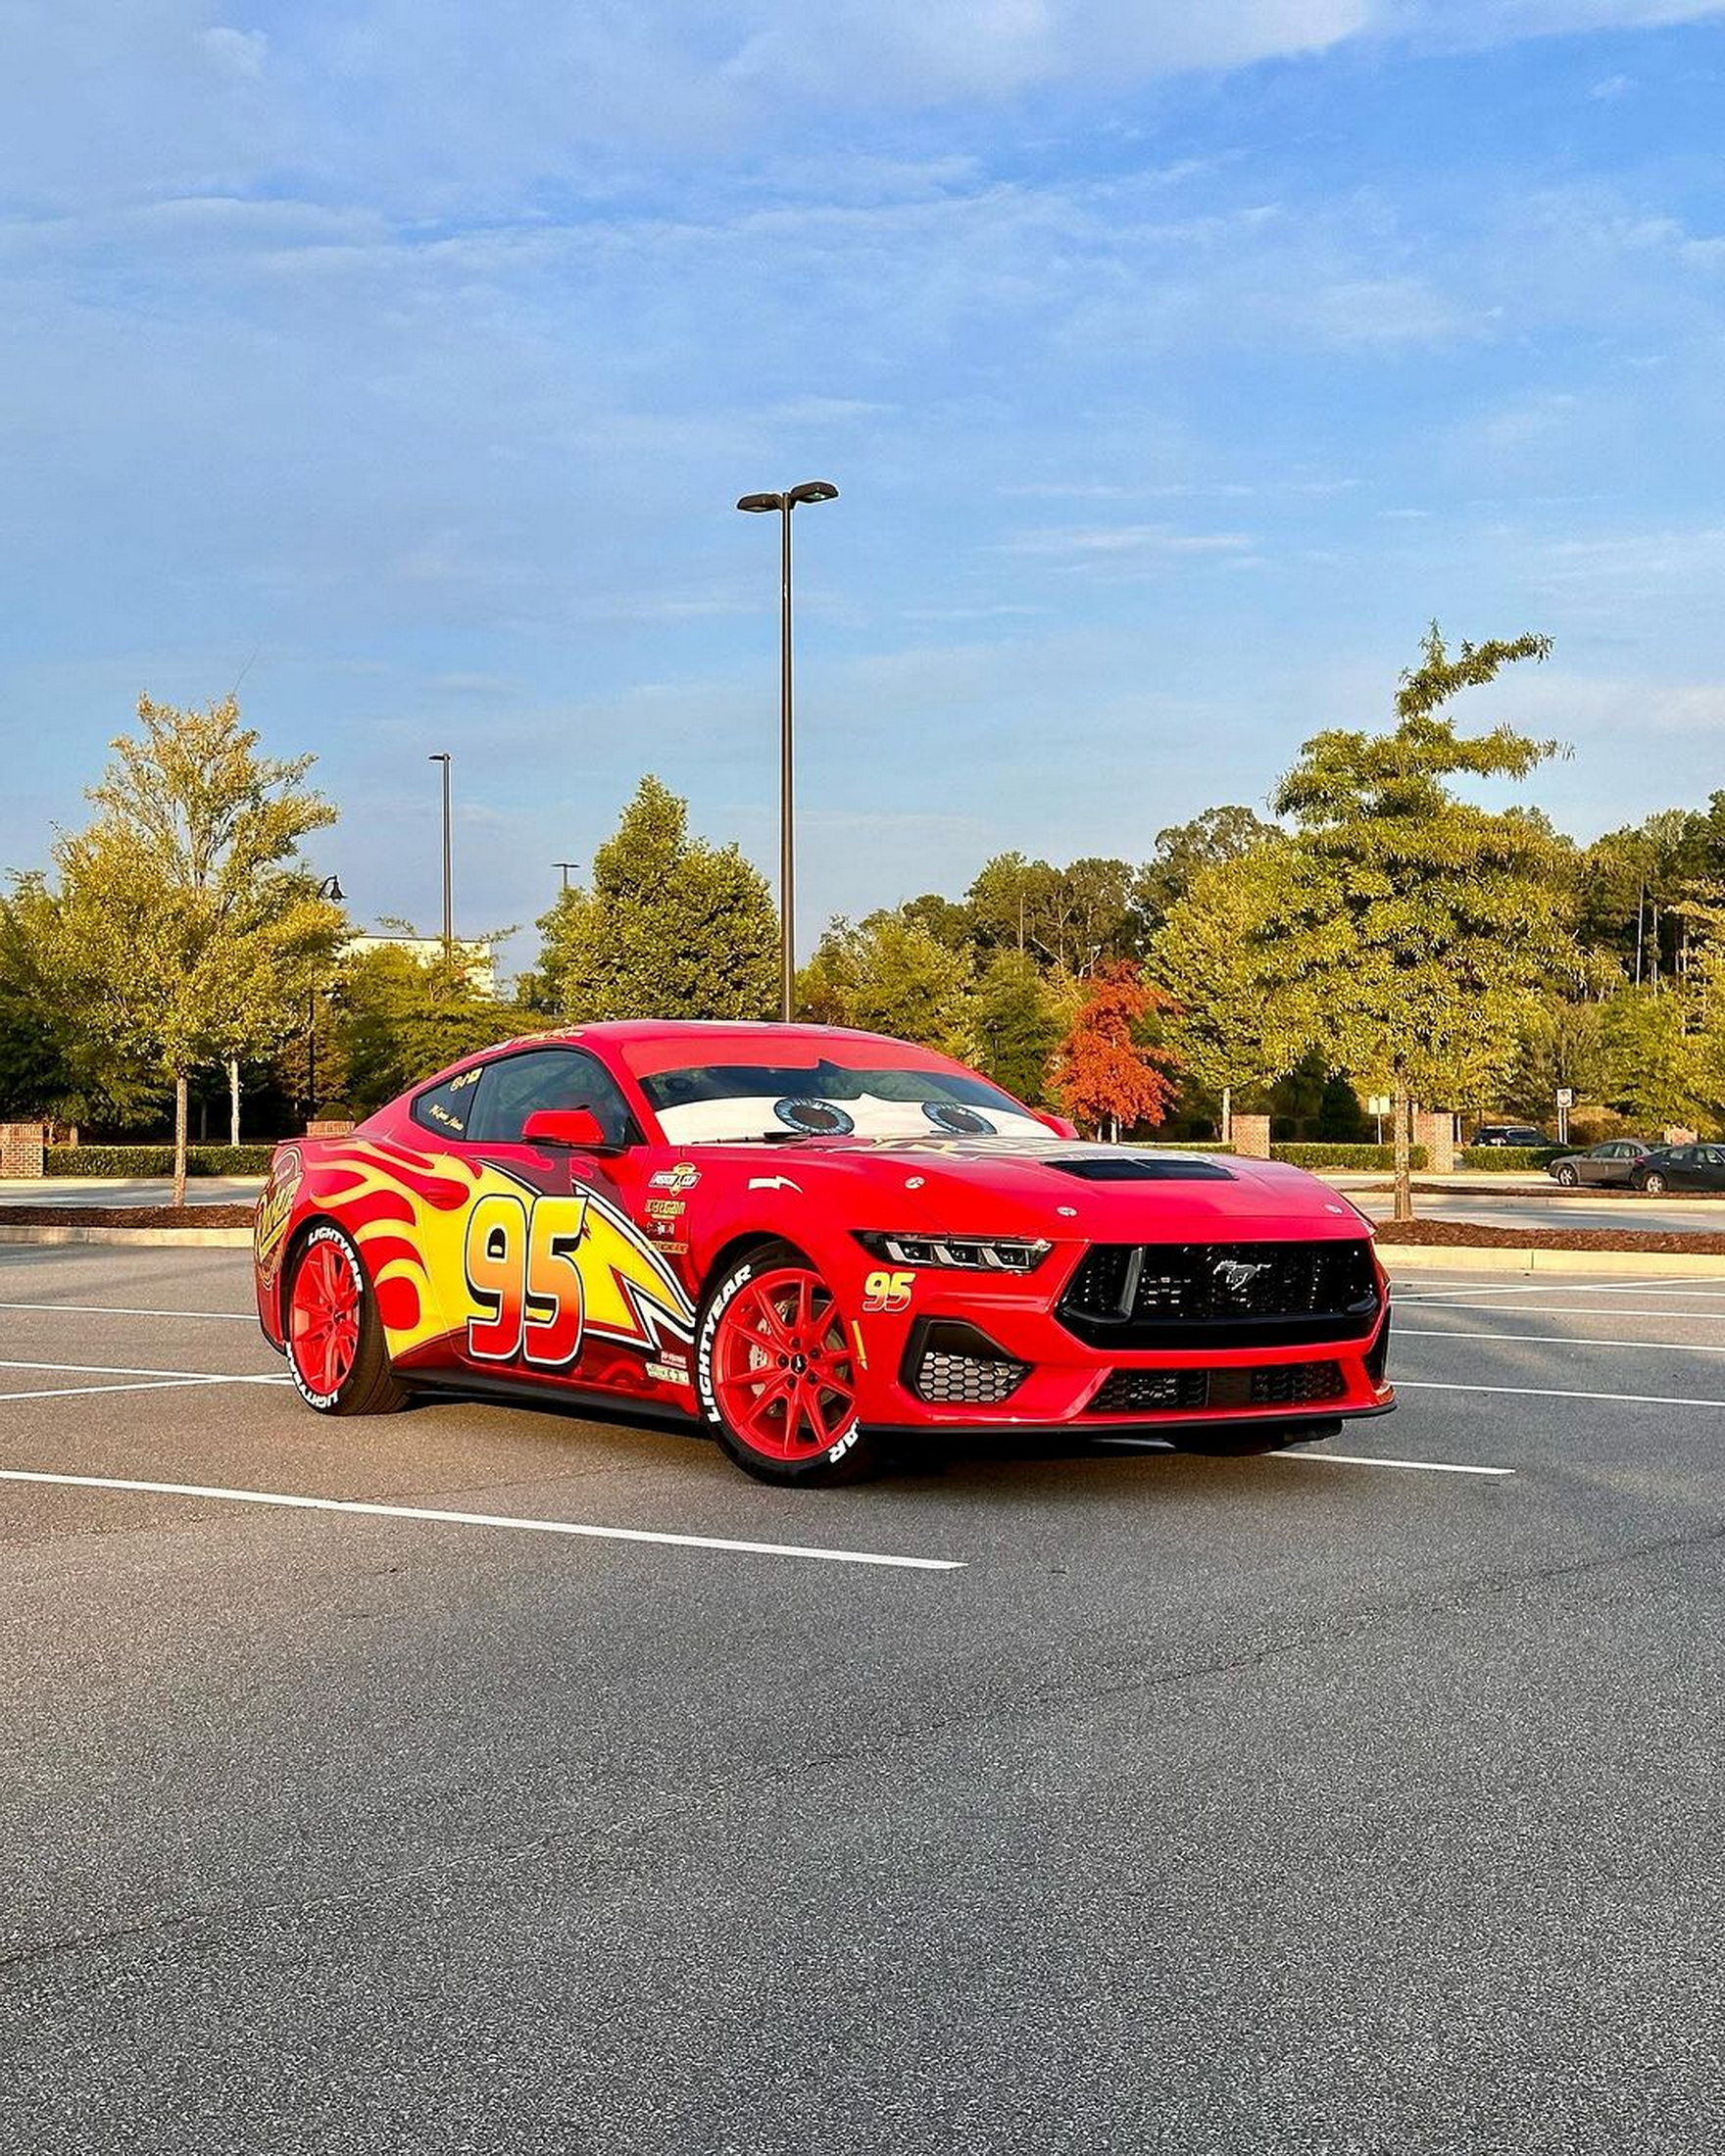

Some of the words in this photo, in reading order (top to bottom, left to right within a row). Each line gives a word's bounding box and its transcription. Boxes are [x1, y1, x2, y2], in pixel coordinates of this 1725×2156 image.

[308, 1226, 364, 1292] LIGHTYEAR
[467, 1195, 588, 1366] 95
[862, 1271, 916, 1312] 95
[697, 1264, 752, 1422] LIGHTYEAR
